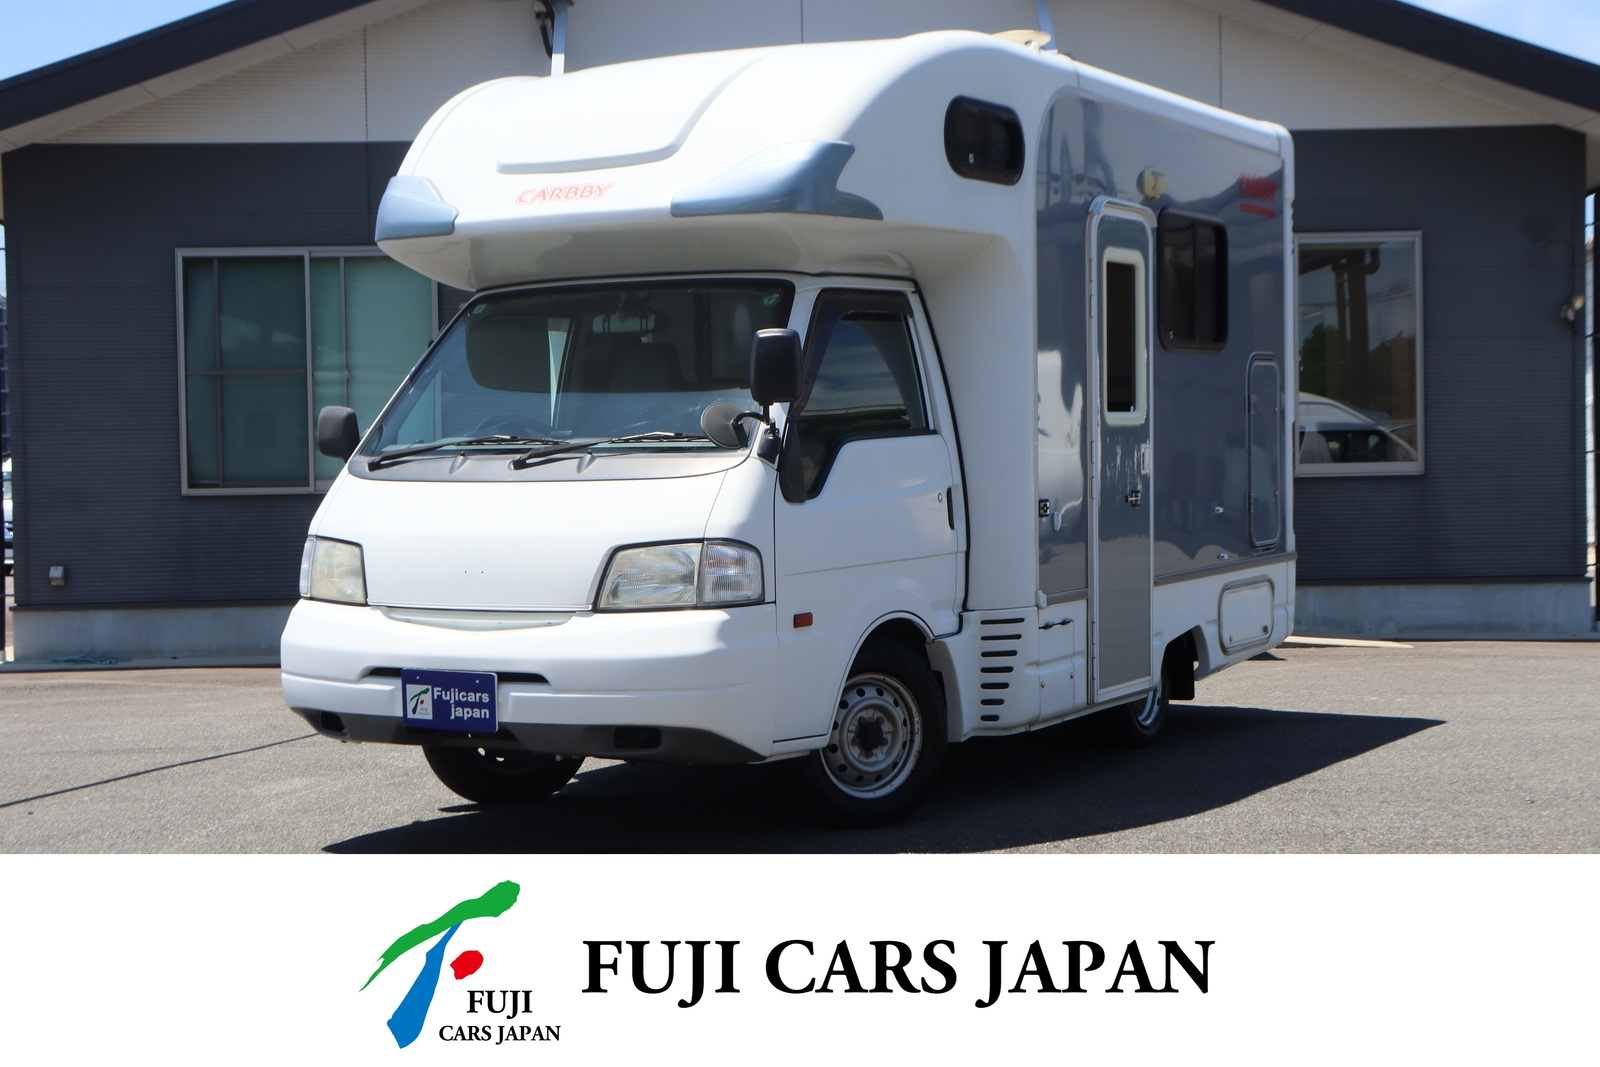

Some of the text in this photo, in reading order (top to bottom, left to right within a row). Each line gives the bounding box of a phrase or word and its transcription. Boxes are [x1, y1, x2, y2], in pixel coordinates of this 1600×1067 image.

[515, 183, 615, 204] CARBBY
[433, 687, 490, 703] Fujicars
[450, 704, 490, 720] japan
